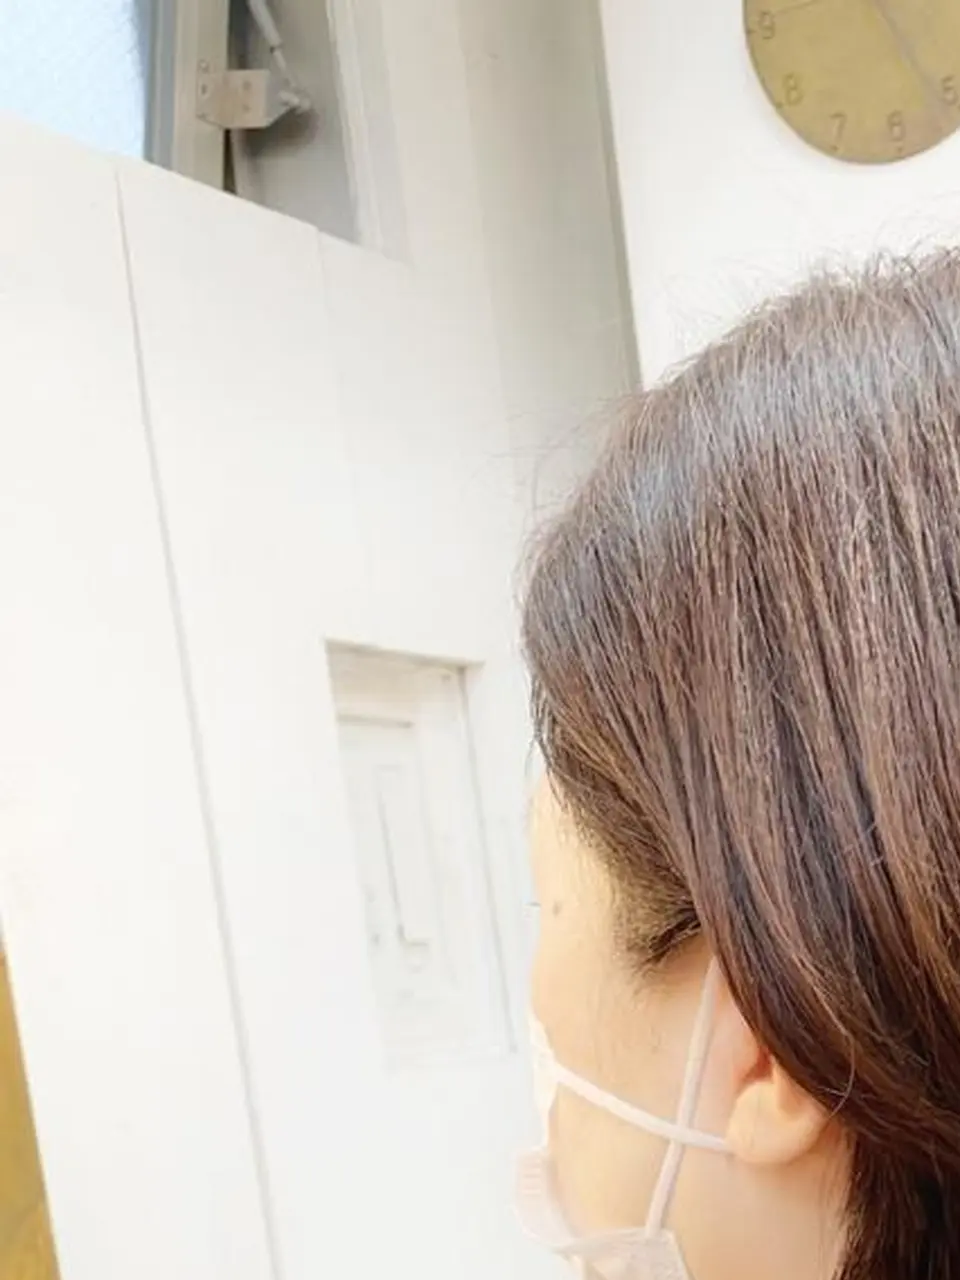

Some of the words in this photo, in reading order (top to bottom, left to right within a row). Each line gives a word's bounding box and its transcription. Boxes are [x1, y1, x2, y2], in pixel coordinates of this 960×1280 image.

[758, 10, 775, 40] 9
[781, 72, 804, 106] 8
[941, 74, 959, 106] 5
[829, 112, 848, 142] 7
[886, 109, 907, 142] 6
